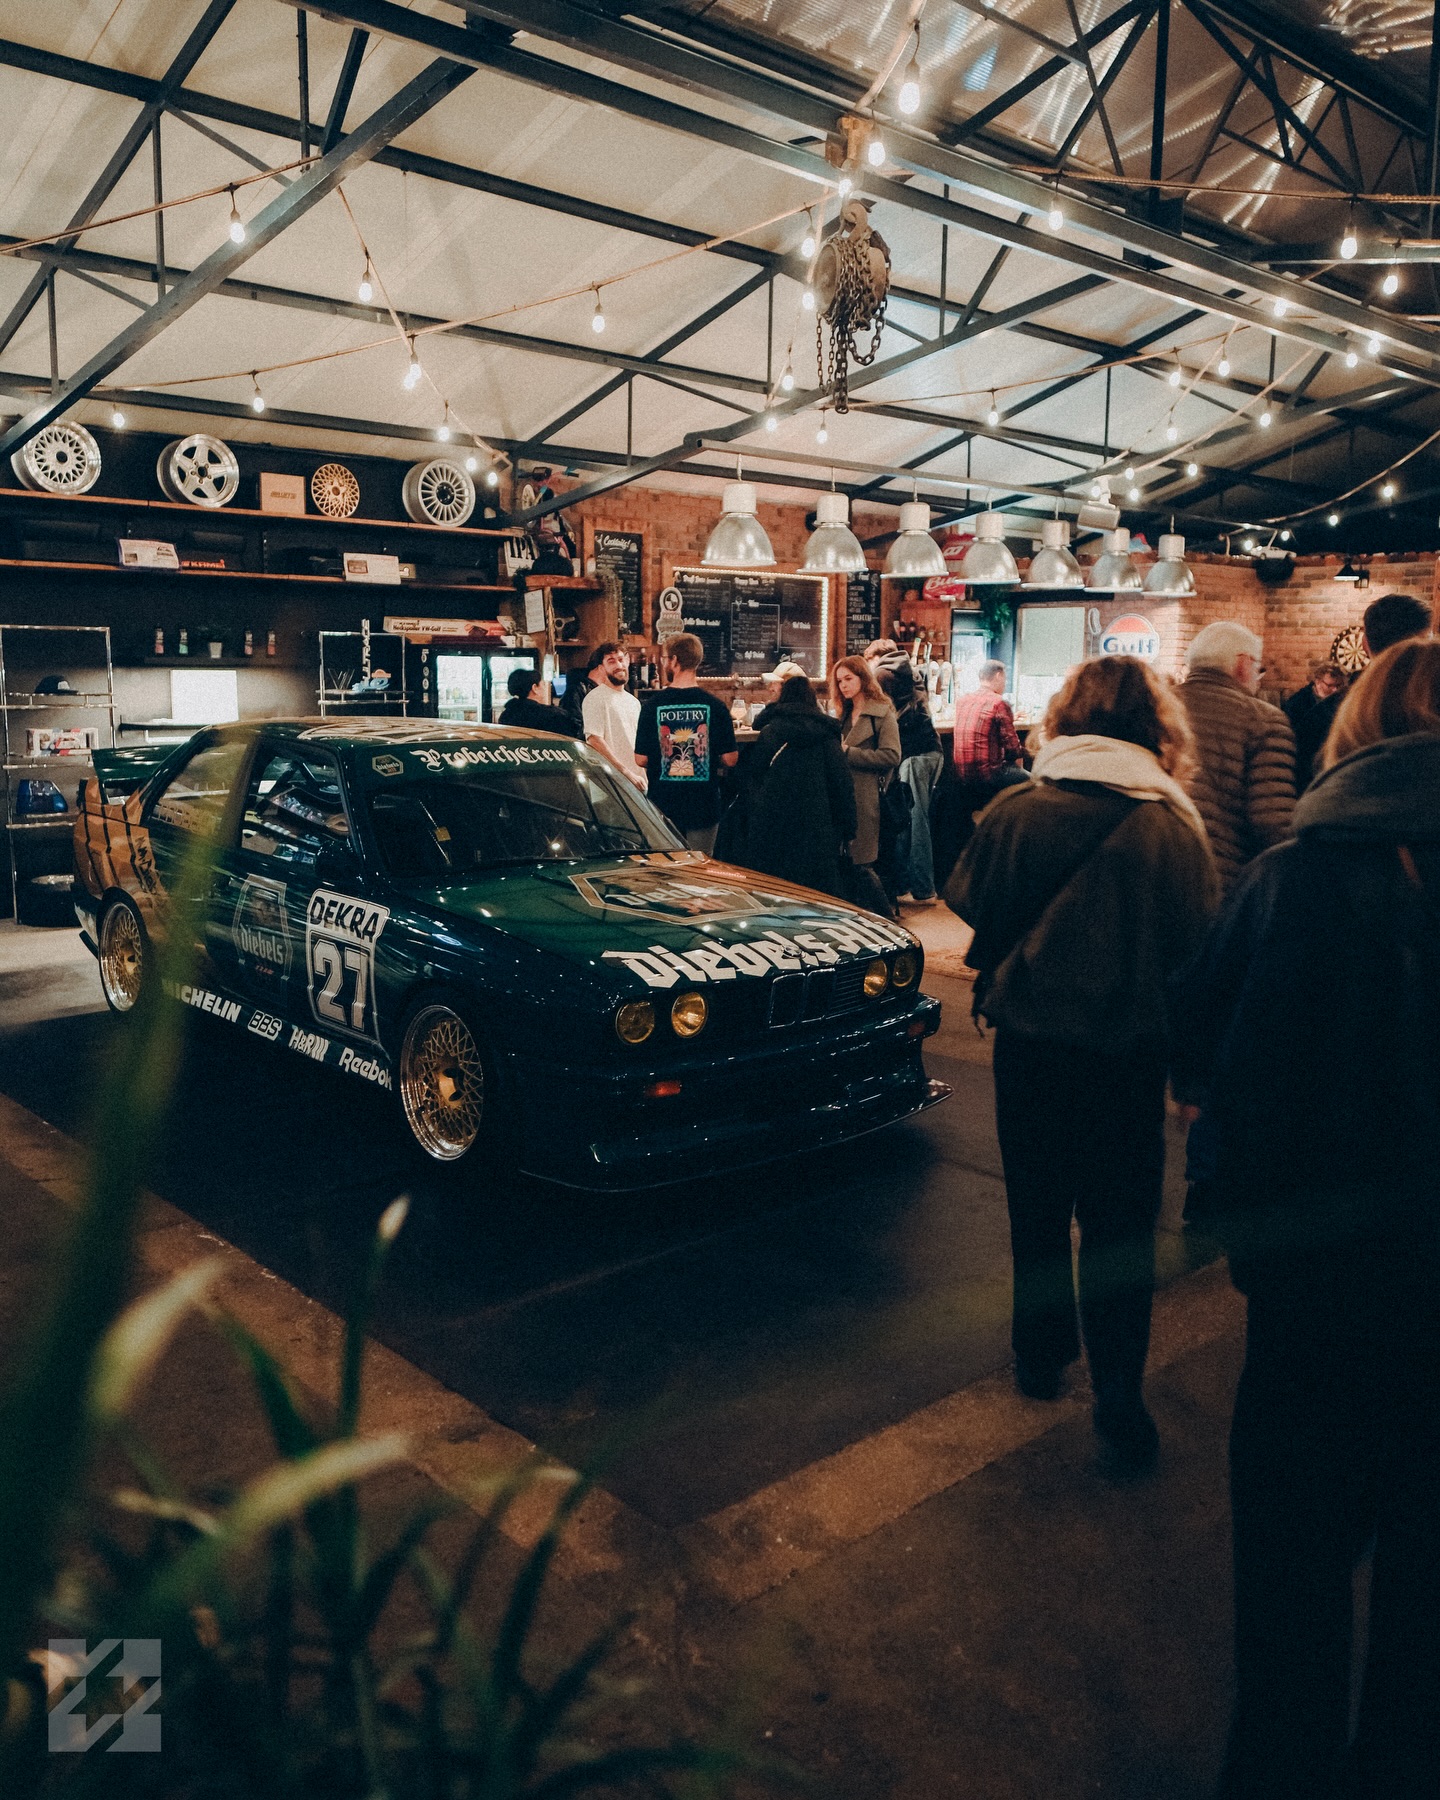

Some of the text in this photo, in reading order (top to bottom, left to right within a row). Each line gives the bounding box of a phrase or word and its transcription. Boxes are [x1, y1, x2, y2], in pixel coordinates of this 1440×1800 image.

[1103, 636, 1156, 654] Gulf
[660, 710, 706, 722] POETRY
[310, 896, 380, 942] DEKRA
[313, 939, 370, 1031] 27
[248, 1010, 282, 1040] BBS
[338, 1047, 393, 1091] Reebok
